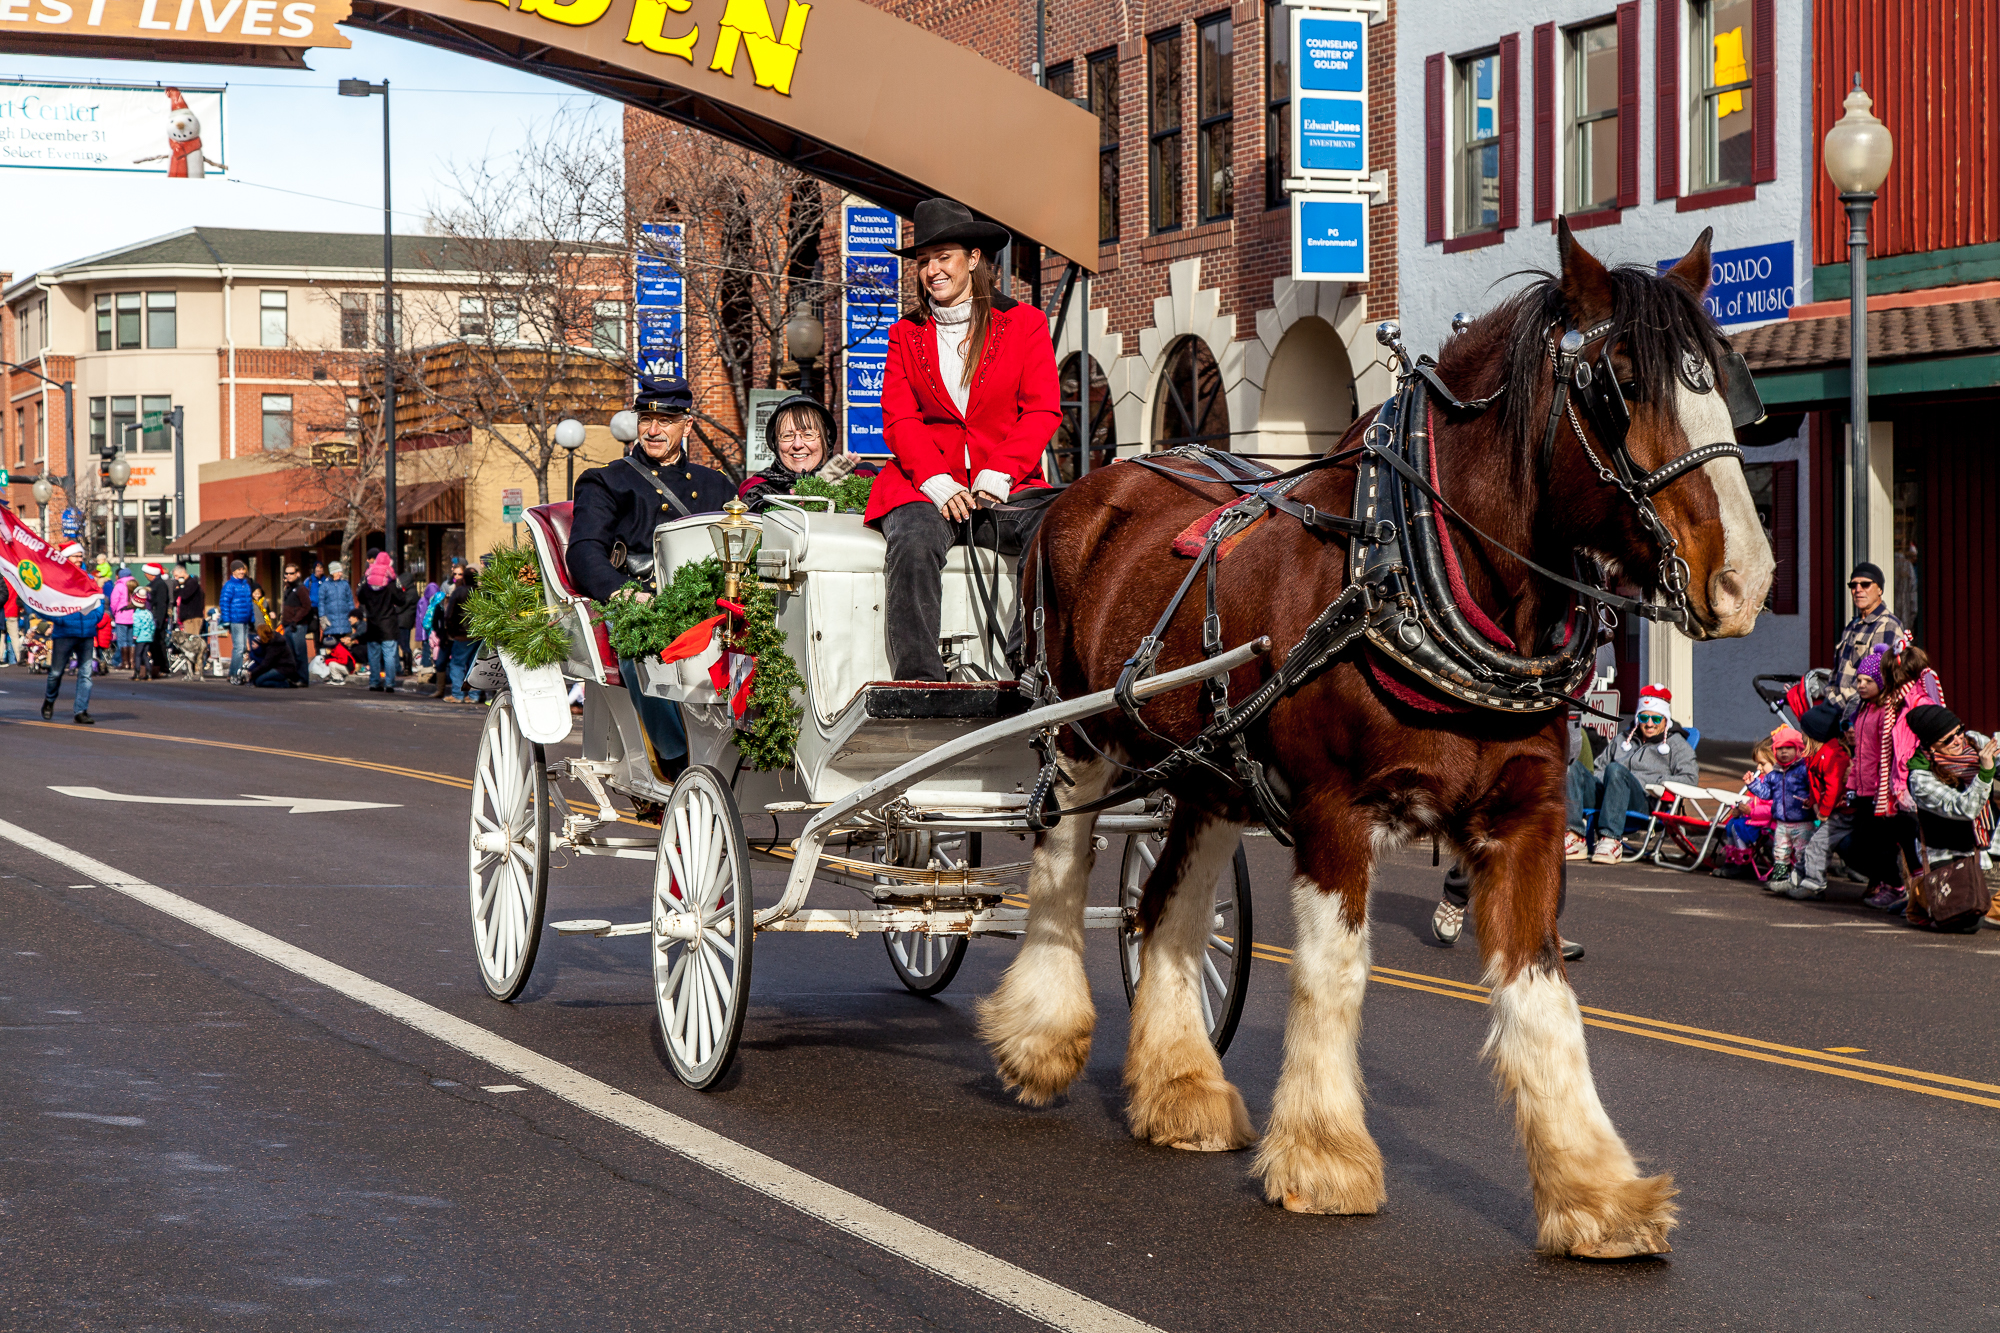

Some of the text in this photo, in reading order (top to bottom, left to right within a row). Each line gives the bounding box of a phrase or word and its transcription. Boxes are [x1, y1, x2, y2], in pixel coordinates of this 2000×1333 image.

[138, 0, 316, 38] LIVES
[1305, 38, 1358, 50] COUNSELING
[1309, 48, 1355, 60] CENTER OF
[1313, 59, 1349, 70] GOLDEN
[0, 95, 99, 122] rt Center
[20, 128, 88, 142] December
[92, 130, 106, 142] 31
[1309, 139, 1356, 148] INVESTMENTS
[3, 145, 108, 164] Select Evenings
[1327, 228, 1339, 237] PG
[1307, 237, 1358, 247] Environmental
[1711, 256, 1772, 286] ORADO
[1727, 291, 1744, 316] of
[1747, 286, 1794, 314] MUSIC
[848, 361, 877, 370] Golden
[12, 525, 46, 552] TROOP
[28, 596, 82, 615] COLORADO
